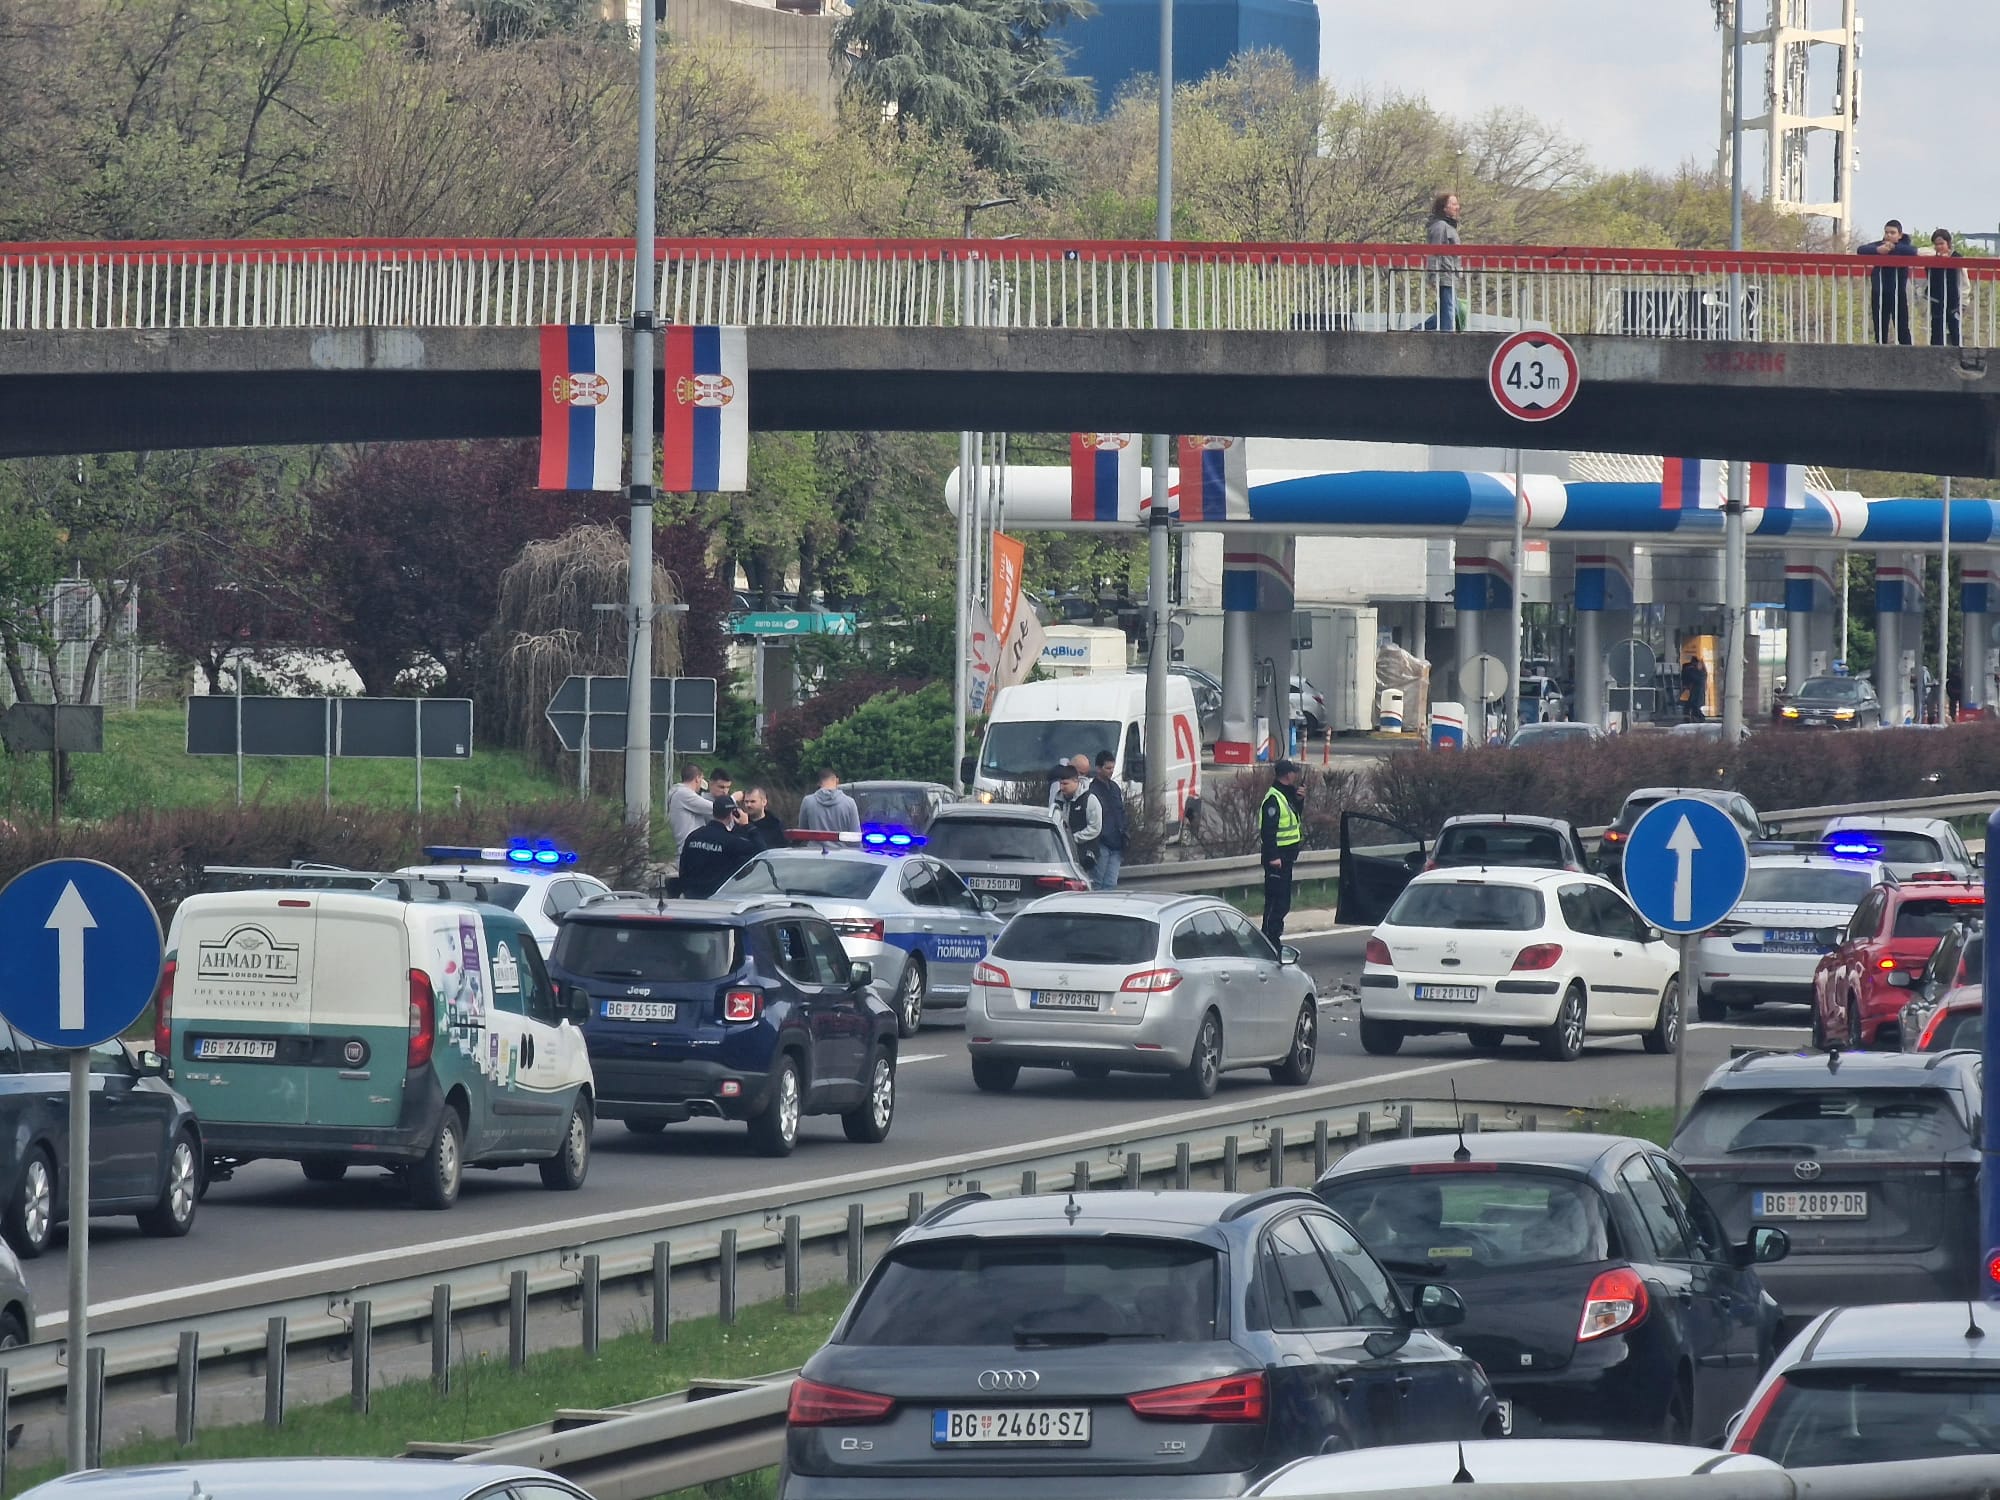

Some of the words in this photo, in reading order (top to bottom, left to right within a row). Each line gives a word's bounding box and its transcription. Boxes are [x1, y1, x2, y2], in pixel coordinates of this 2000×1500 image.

[1506, 361, 1544, 389] 4.3
[1547, 376, 1560, 389] m
[1042, 646, 1085, 658] AdBlue
[937, 946, 981, 960] ПОЛИЦИЈА
[1761, 945, 1818, 954] ПОЛИЦИЈА
[202, 952, 262, 969] AHMAD
[265, 954, 291, 970] TE
[627, 986, 651, 997] Jeep
[1038, 992, 1051, 1003] BG
[1423, 986, 1434, 999] UE
[608, 1003, 622, 1016] BG
[203, 1040, 217, 1054] BG
[1765, 1195, 1786, 1213] BG
[951, 1413, 978, 1437] BG
[840, 1438, 874, 1451] Q3
[1161, 1440, 1186, 1449] TDI
